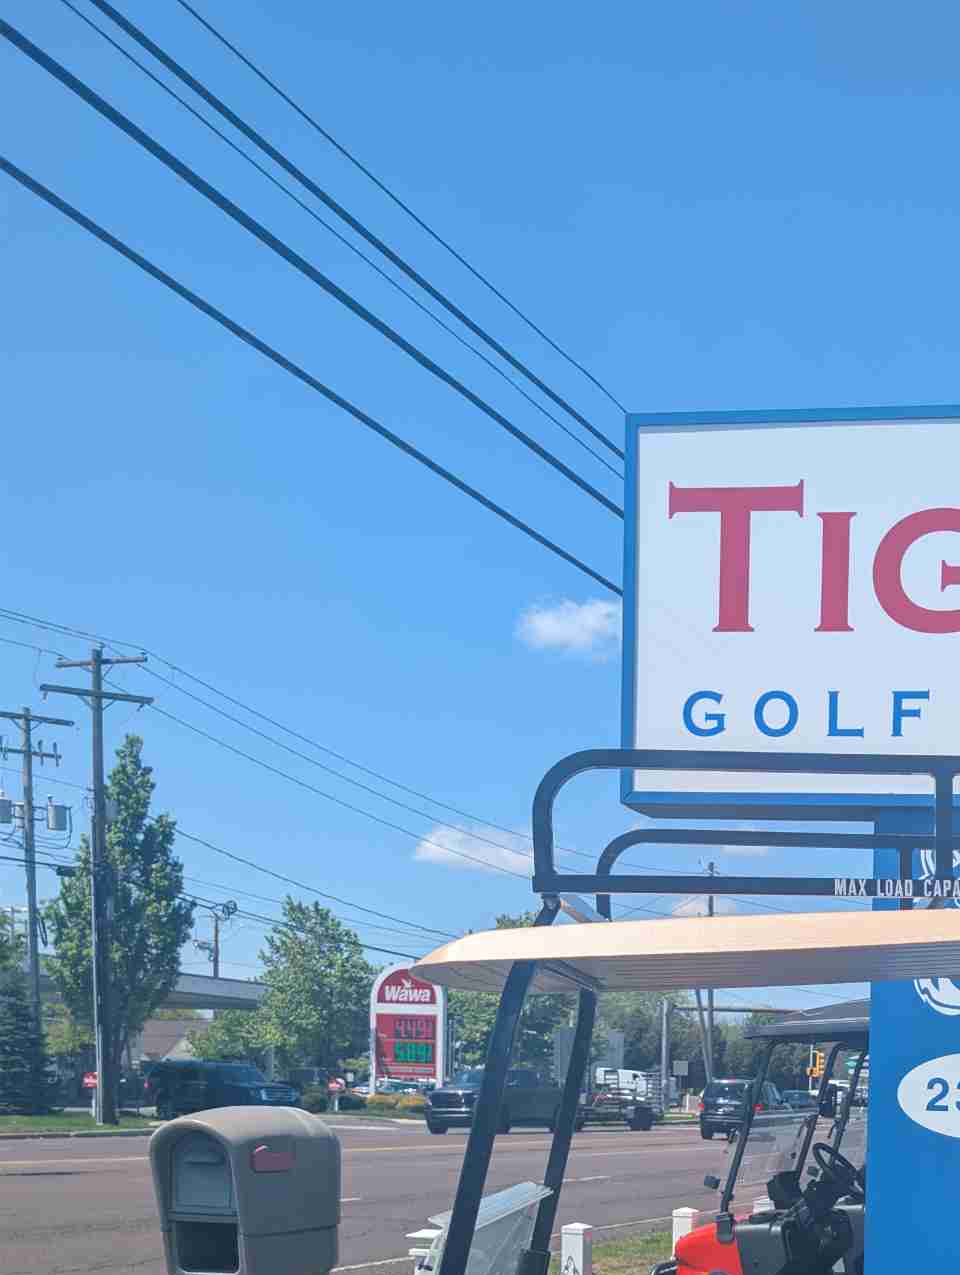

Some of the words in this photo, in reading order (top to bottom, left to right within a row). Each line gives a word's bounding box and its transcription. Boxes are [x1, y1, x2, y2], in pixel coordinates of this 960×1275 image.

[682, 688, 931, 738] GOLF
[834, 880, 867, 896] MAX
[876, 881, 913, 897] LOAD
[384, 985, 432, 1002] Wawa
